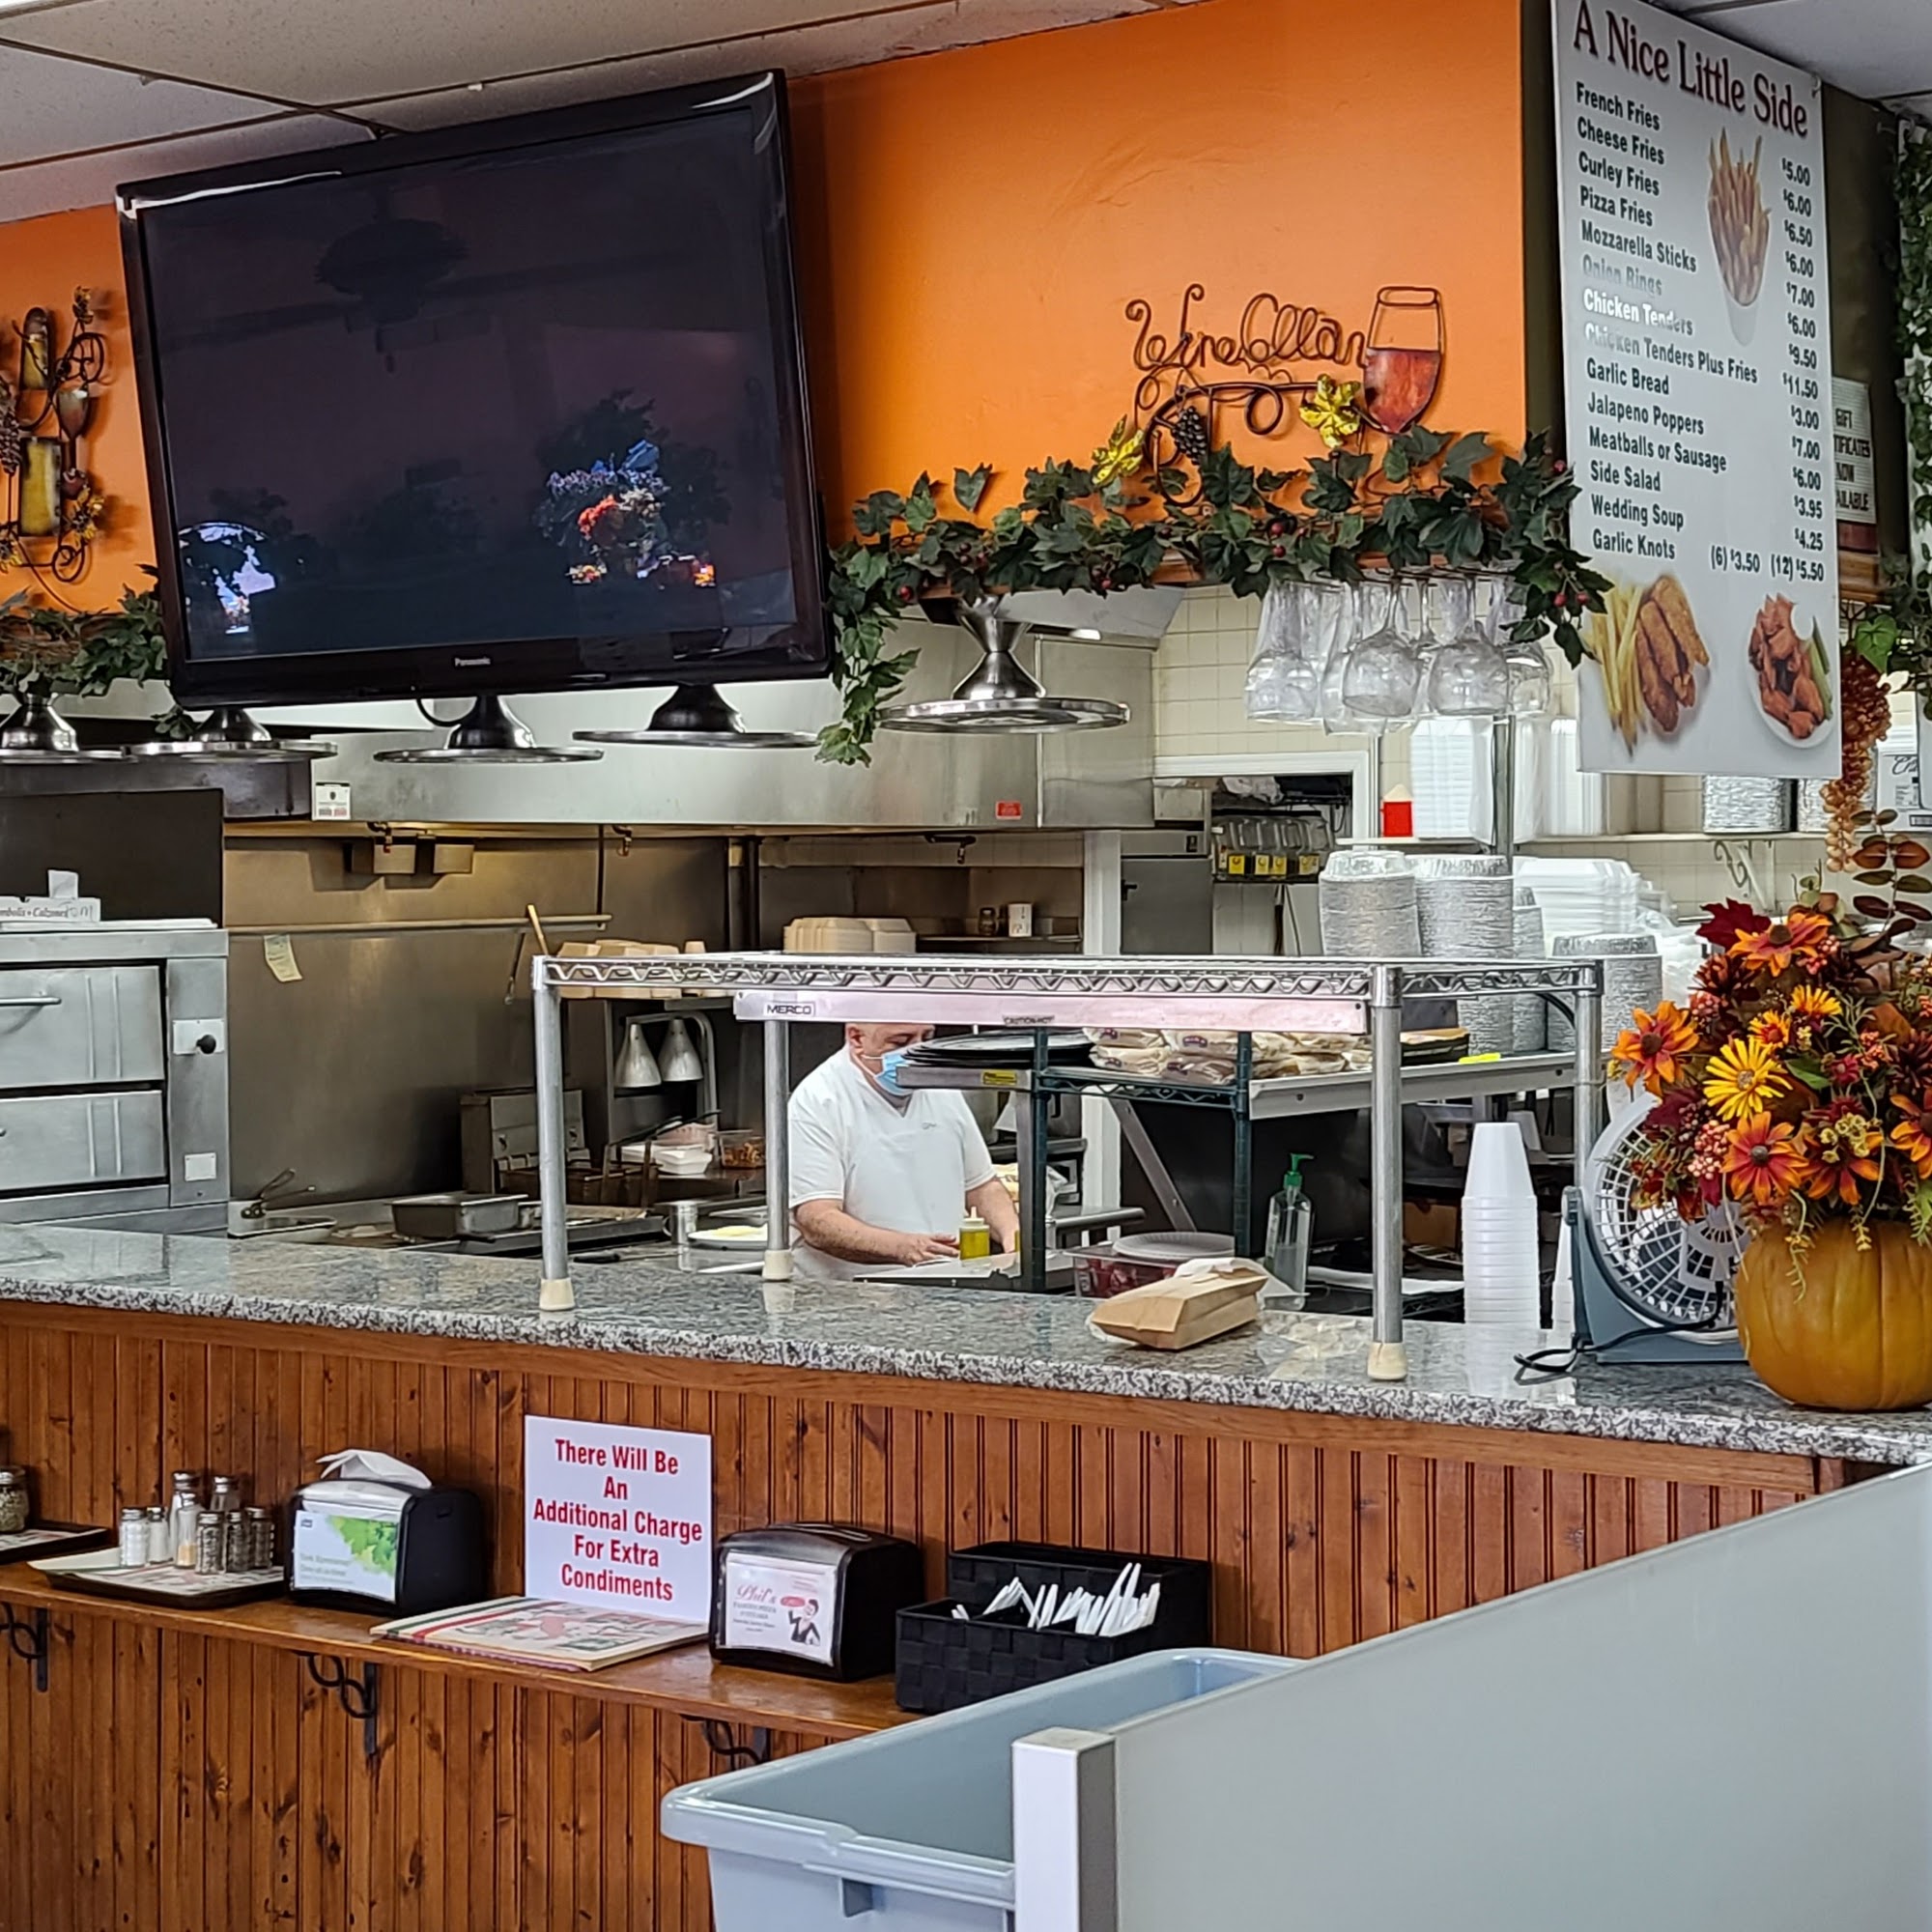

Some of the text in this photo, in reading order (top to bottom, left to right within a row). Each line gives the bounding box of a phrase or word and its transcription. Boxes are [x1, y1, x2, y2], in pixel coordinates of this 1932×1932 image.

[1574, 0, 1808, 138] A Nice Little Side
[1576, 81, 1810, 186] French Fries $5.00
[1577, 116, 1811, 217] Cheese Fries $6.00
[1578, 151, 1812, 247] Curley Fries $6.50
[1579, 185, 1813, 278] Pizza Fries $6.00
[1581, 219, 1815, 308] Mozzarella Sticks $7.00
[1583, 254, 1816, 338] Onion Rings $6.00
[1583, 288, 1817, 370] Chicken Tenders $9.50
[1585, 323, 1818, 400] Chicken Tenders Plus Fries $11.50
[1586, 356, 1819, 430] Garlic Bread $3.00
[1588, 391, 1820, 461] Jalapeno Poppers $7.00
[1589, 425, 1821, 491] Meatballs or Sausage $6.00
[1590, 460, 1823, 520] Side Salad $3.95
[1591, 493, 1824, 552] Wedding Soup $4.25
[1593, 527, 1824, 582] Garlic Knots (6) $3.50 (12) $5.50
[766, 1004, 812, 1015] MERCO
[554, 1438, 679, 1475] There Will Be
[604, 1476, 628, 1500] An
[533, 1498, 702, 1546] Additional Charge
[574, 1534, 659, 1567] For Extra
[561, 1563, 673, 1602] Condiments
